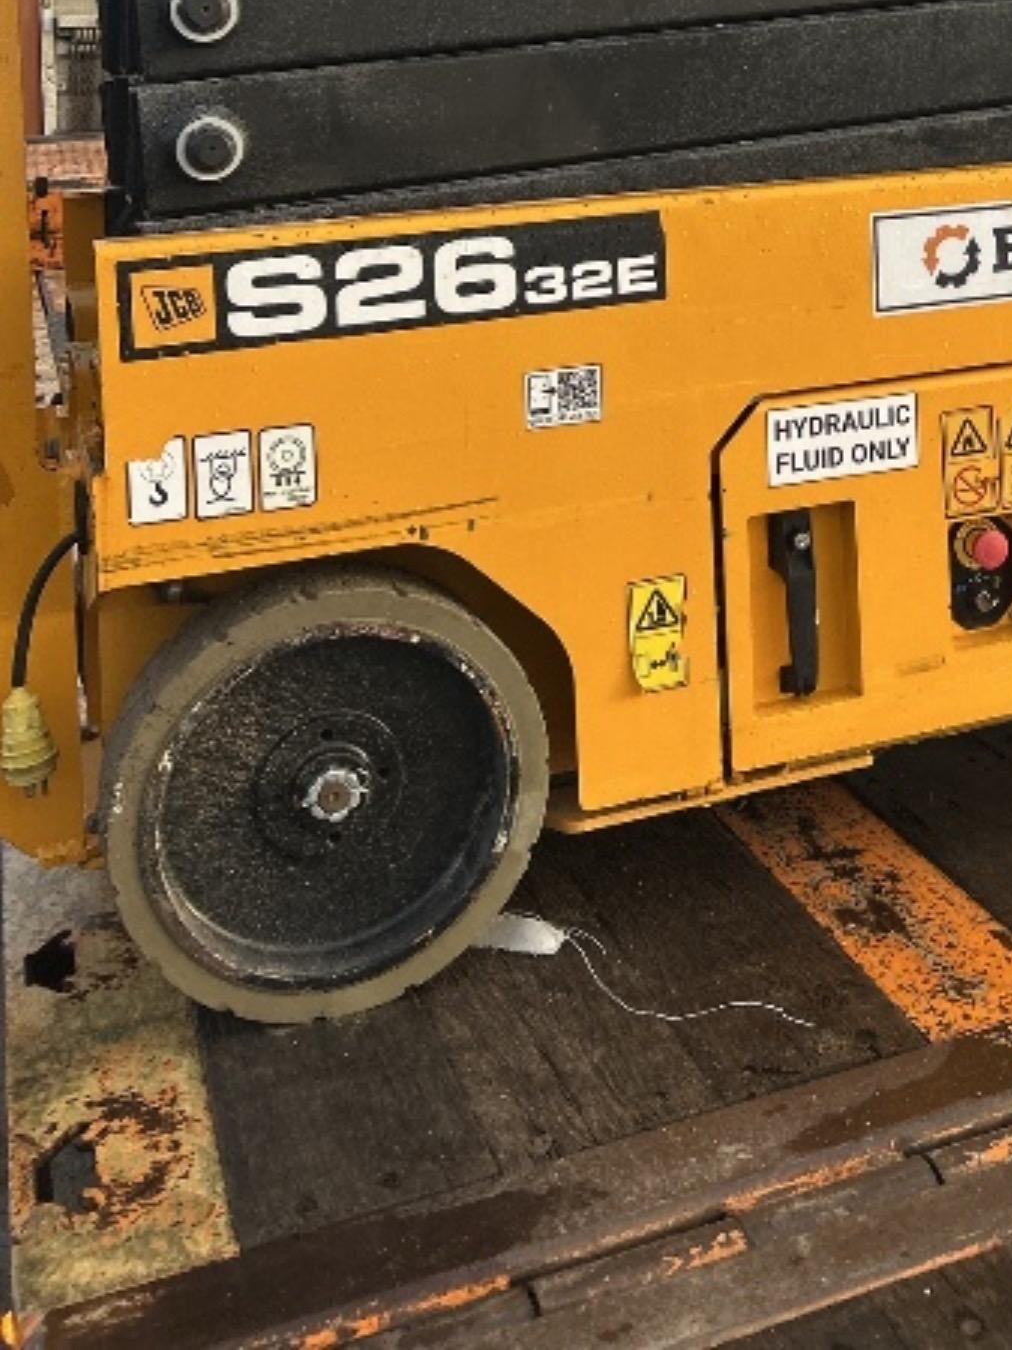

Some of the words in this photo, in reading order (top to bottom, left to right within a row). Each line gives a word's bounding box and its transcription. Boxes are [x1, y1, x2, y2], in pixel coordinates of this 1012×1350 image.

[151, 288, 202, 325] JCB
[225, 236, 517, 338] S26
[525, 254, 658, 305] 32E
[774, 404, 911, 442] HYDRAULIC
[776, 447, 844, 474] FLUID
[851, 436, 911, 465] ONLY
